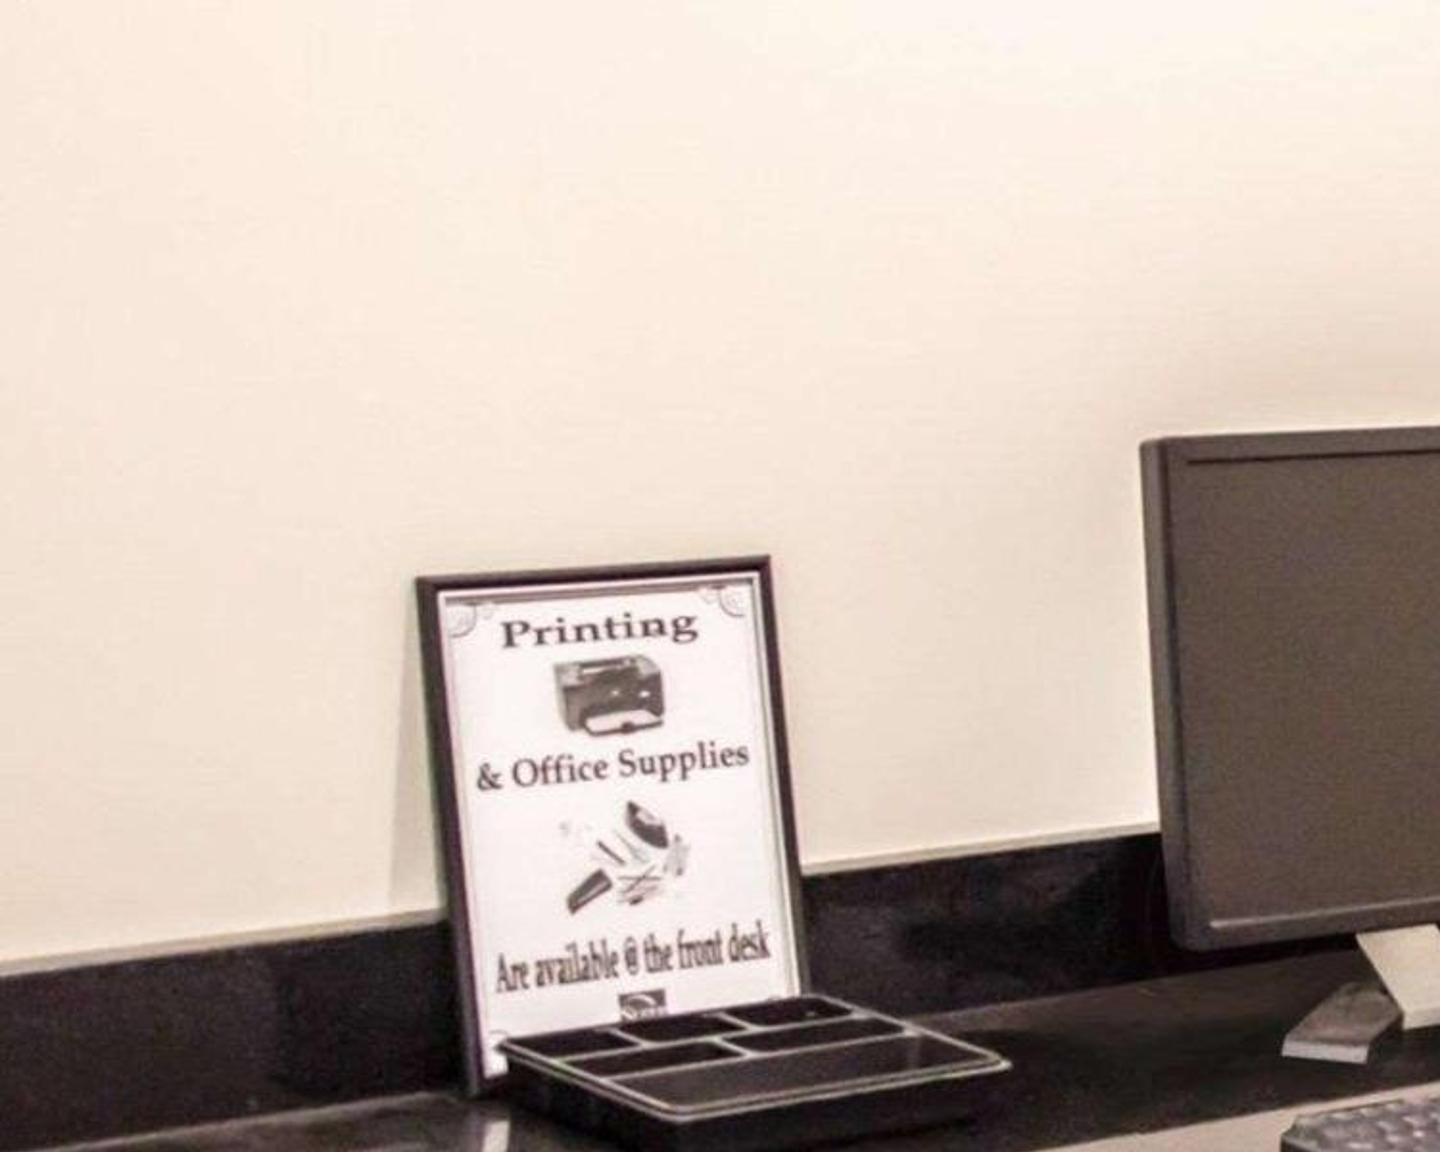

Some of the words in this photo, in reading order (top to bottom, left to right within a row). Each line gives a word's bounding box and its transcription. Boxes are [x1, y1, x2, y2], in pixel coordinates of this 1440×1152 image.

[501, 611, 699, 649] Printing
[476, 762, 504, 791] &
[511, 753, 609, 788] Office
[618, 740, 750, 783] Supplies
[495, 952, 530, 992] Are
[535, 937, 620, 985] available
[624, 936, 640, 976] @
[643, 933, 674, 973] the
[677, 928, 724, 970] front
[729, 918, 771, 962] desk
